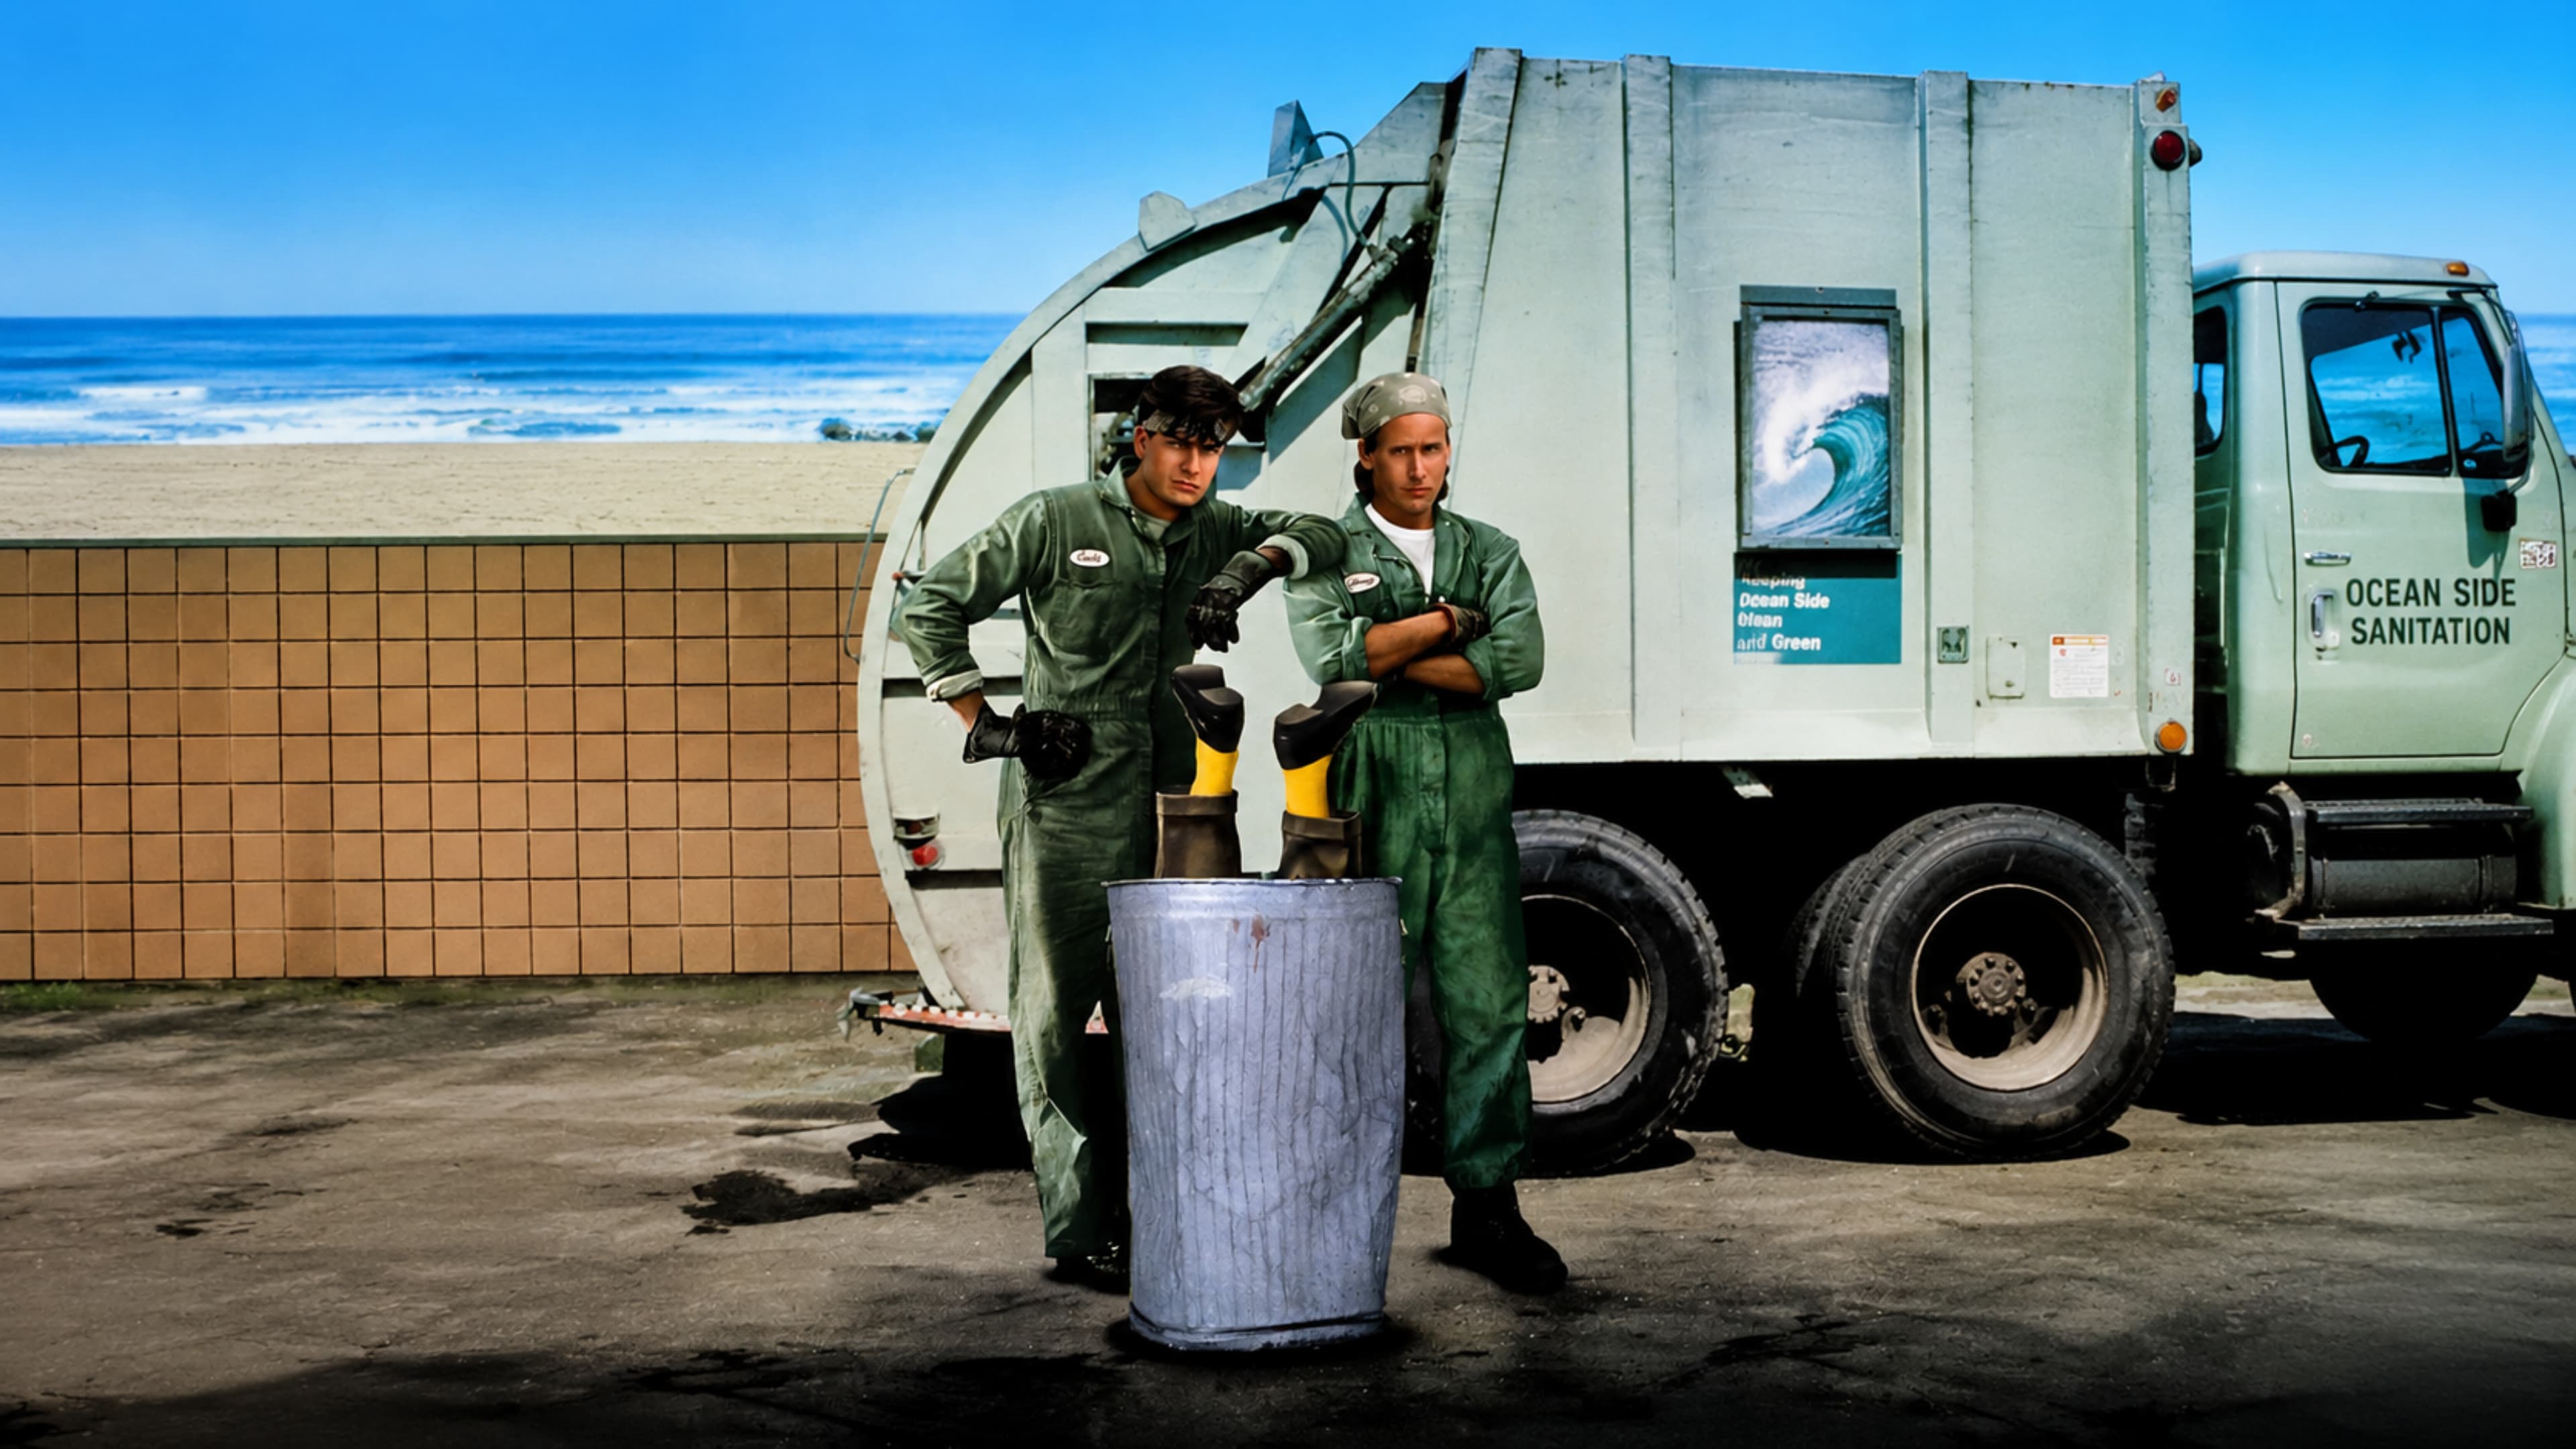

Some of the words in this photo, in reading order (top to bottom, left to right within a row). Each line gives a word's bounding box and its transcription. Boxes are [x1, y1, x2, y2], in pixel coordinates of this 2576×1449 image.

[1739, 592, 1789, 608] Ocean
[1794, 592, 1830, 608] Side
[2347, 578, 2440, 606] OCEAN
[2454, 578, 2516, 606] SIDE
[1772, 633, 1821, 650] Green
[2351, 617, 2510, 645] SANITATION
